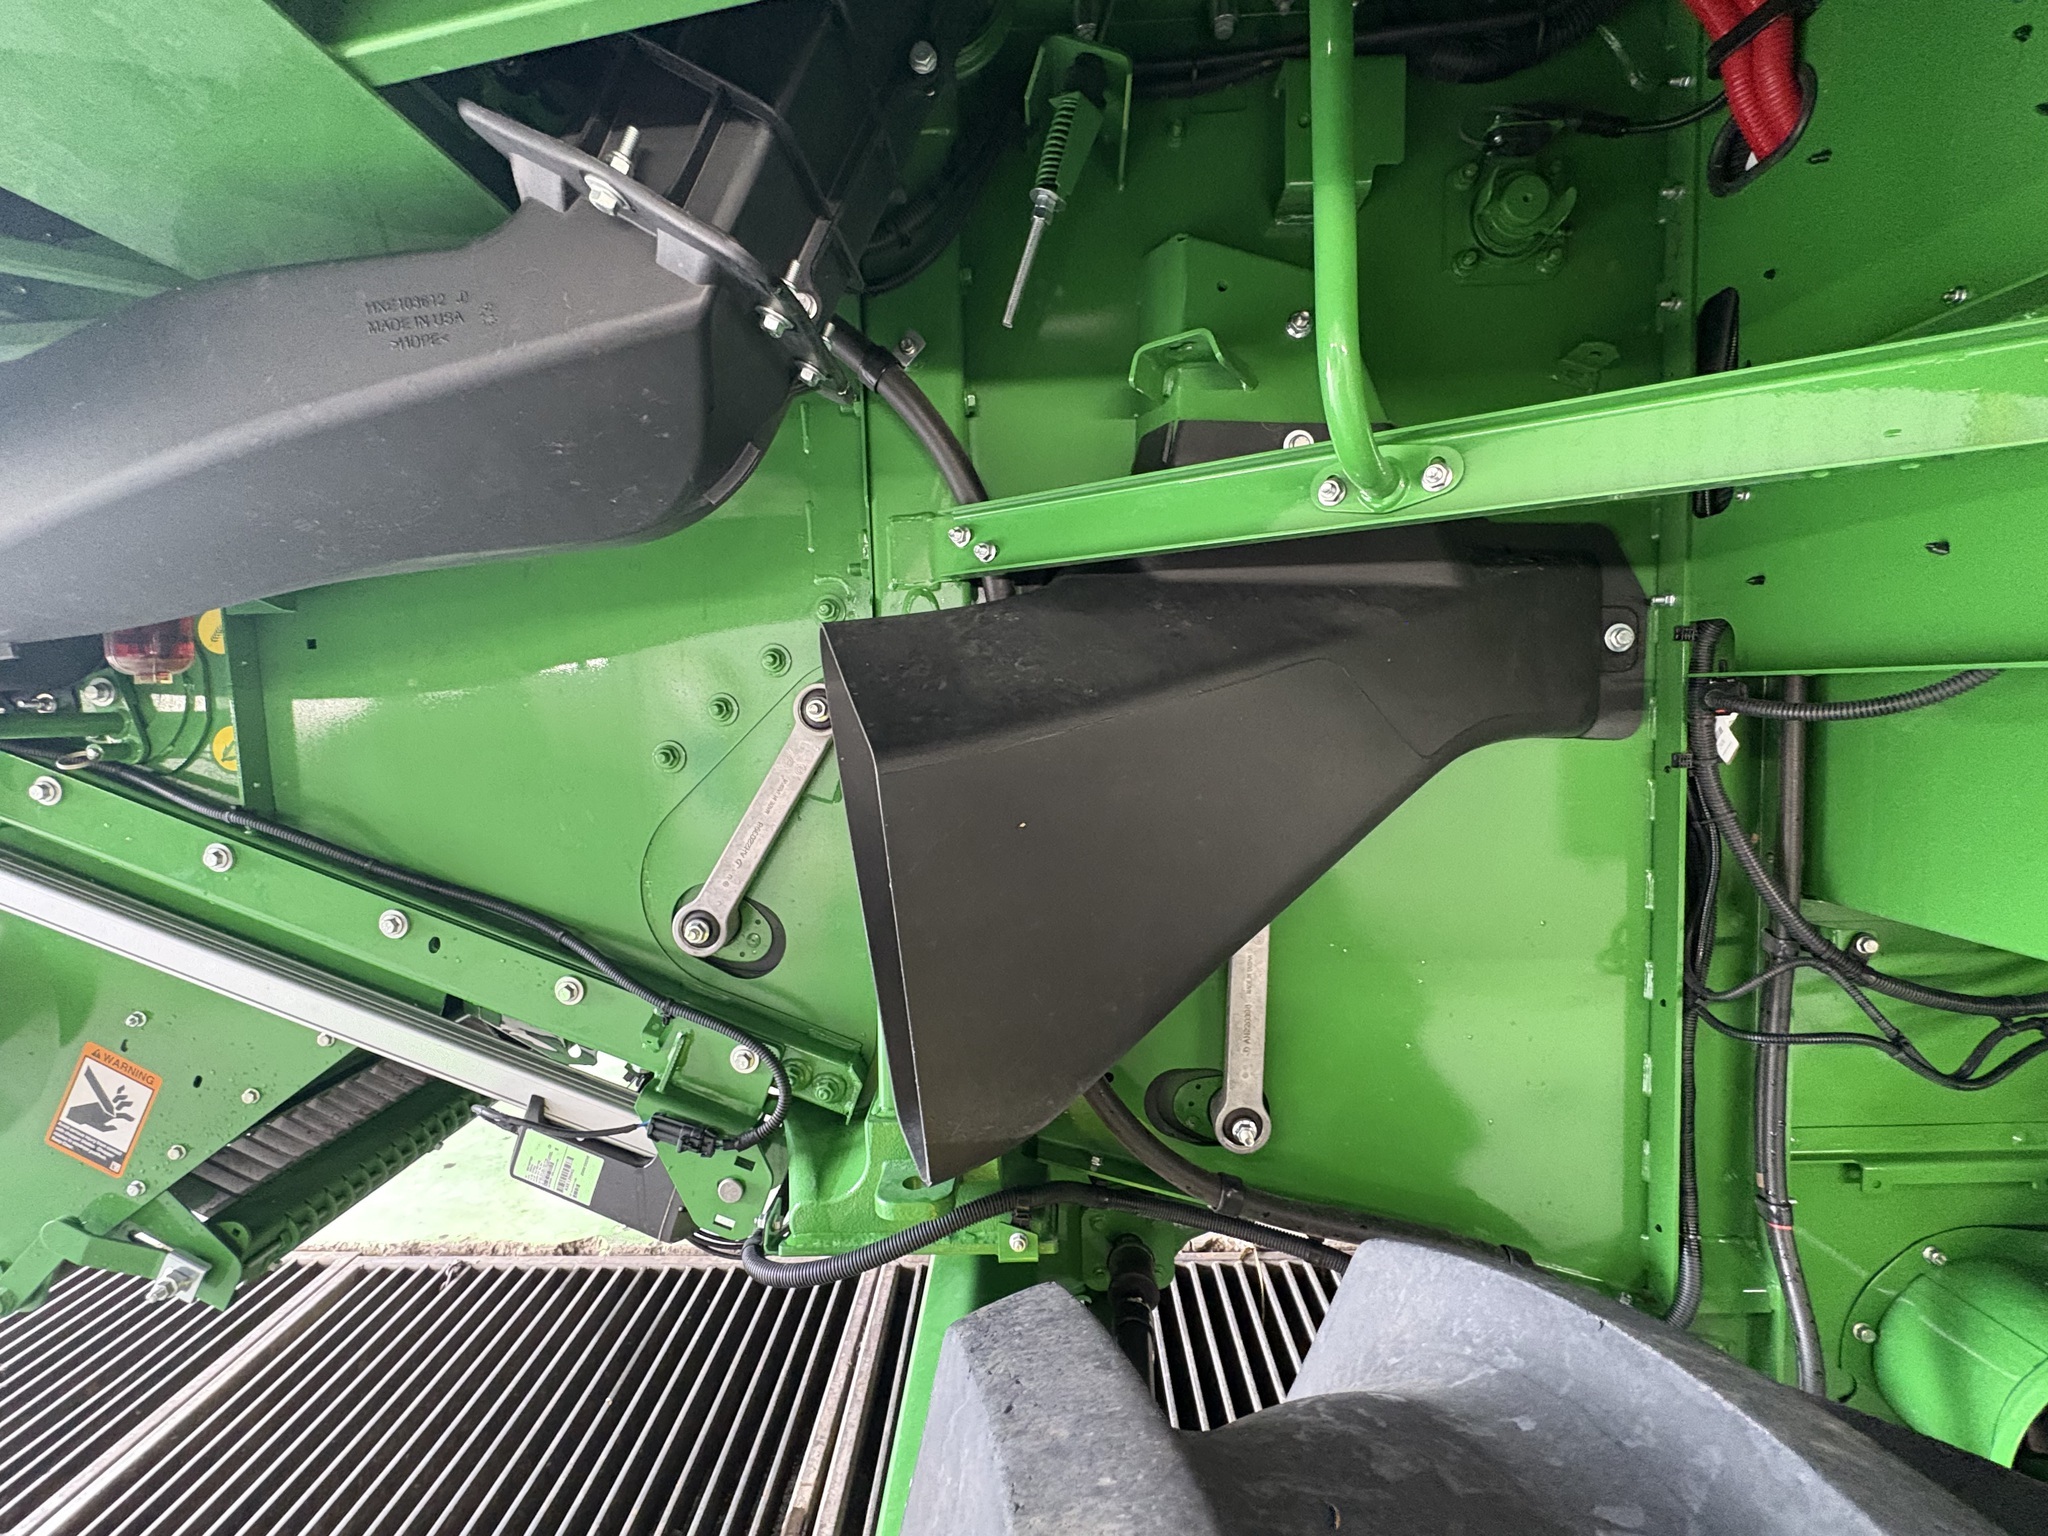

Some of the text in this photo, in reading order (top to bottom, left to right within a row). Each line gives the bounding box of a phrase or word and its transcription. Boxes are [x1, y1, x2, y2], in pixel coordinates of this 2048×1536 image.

[367, 310, 465, 335] MADE IN USA
[103, 1053, 155, 1086] WARNING
